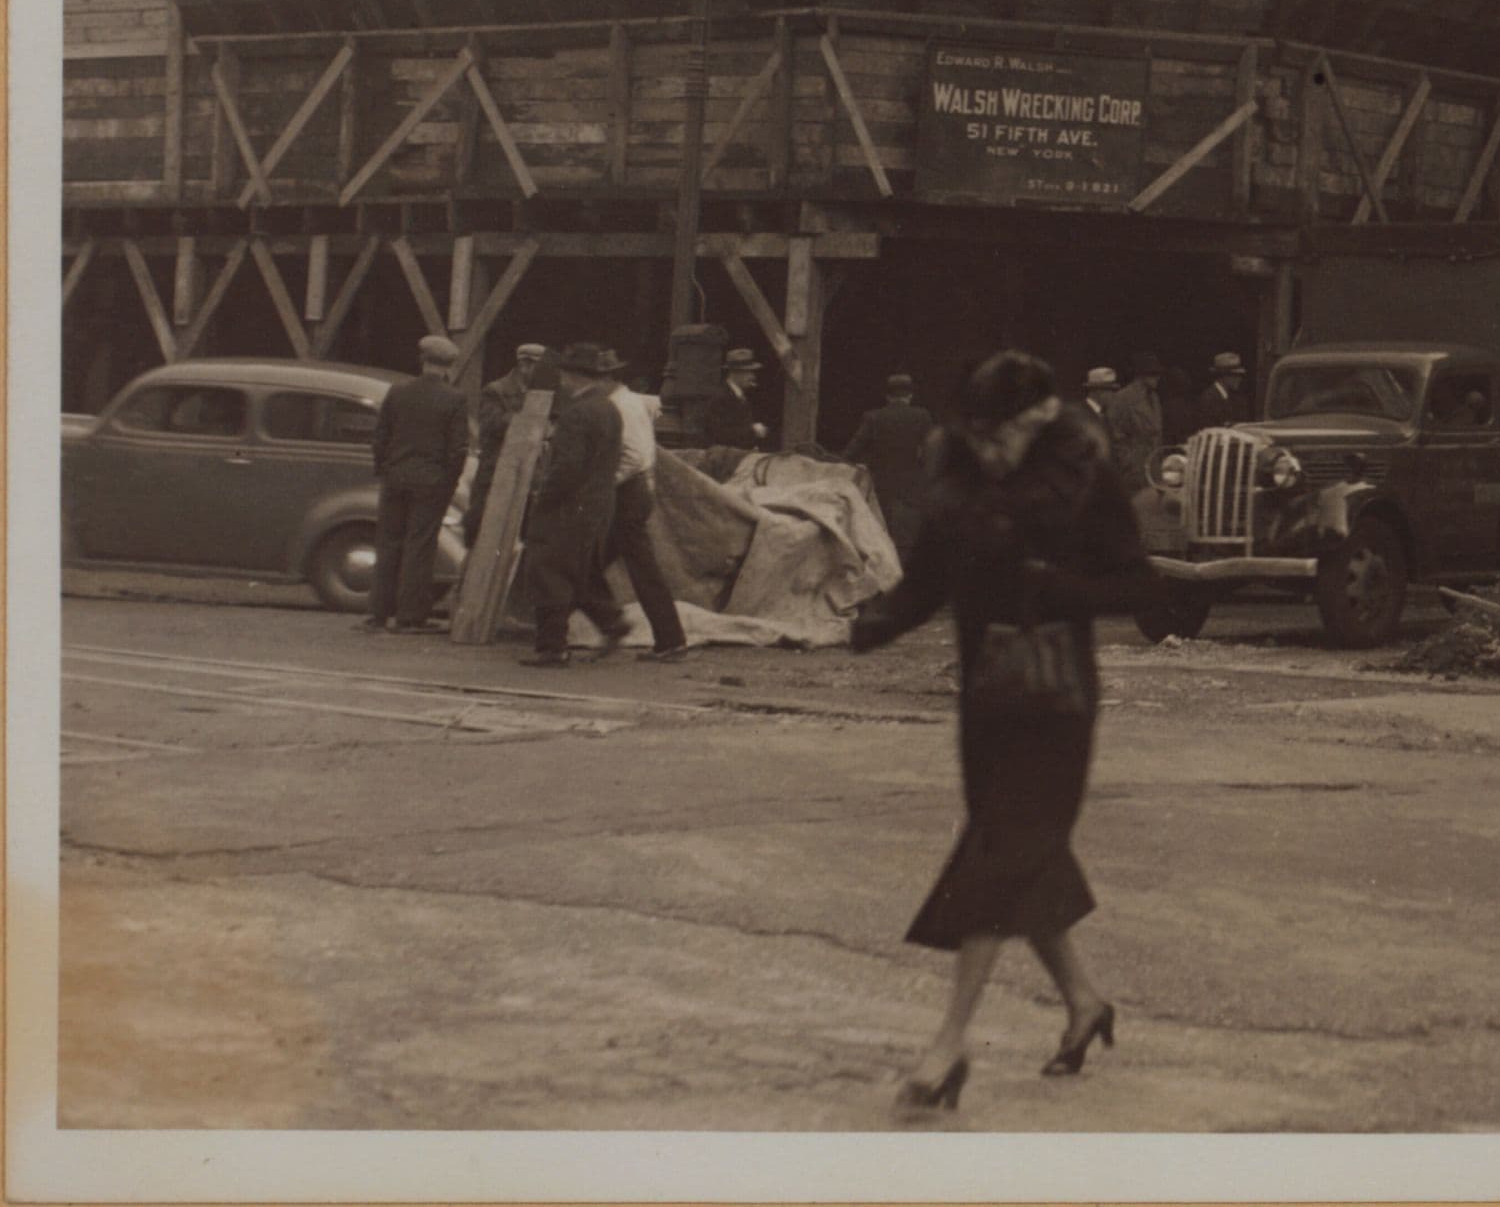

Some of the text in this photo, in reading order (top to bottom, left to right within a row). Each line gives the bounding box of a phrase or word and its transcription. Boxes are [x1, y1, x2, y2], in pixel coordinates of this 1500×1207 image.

[933, 81, 998, 115] WALSH
[1002, 87, 1095, 122] WRECKING
[966, 122, 1098, 146] 51 FIFTH AVE.
[986, 146, 1074, 160] NEW YORK
